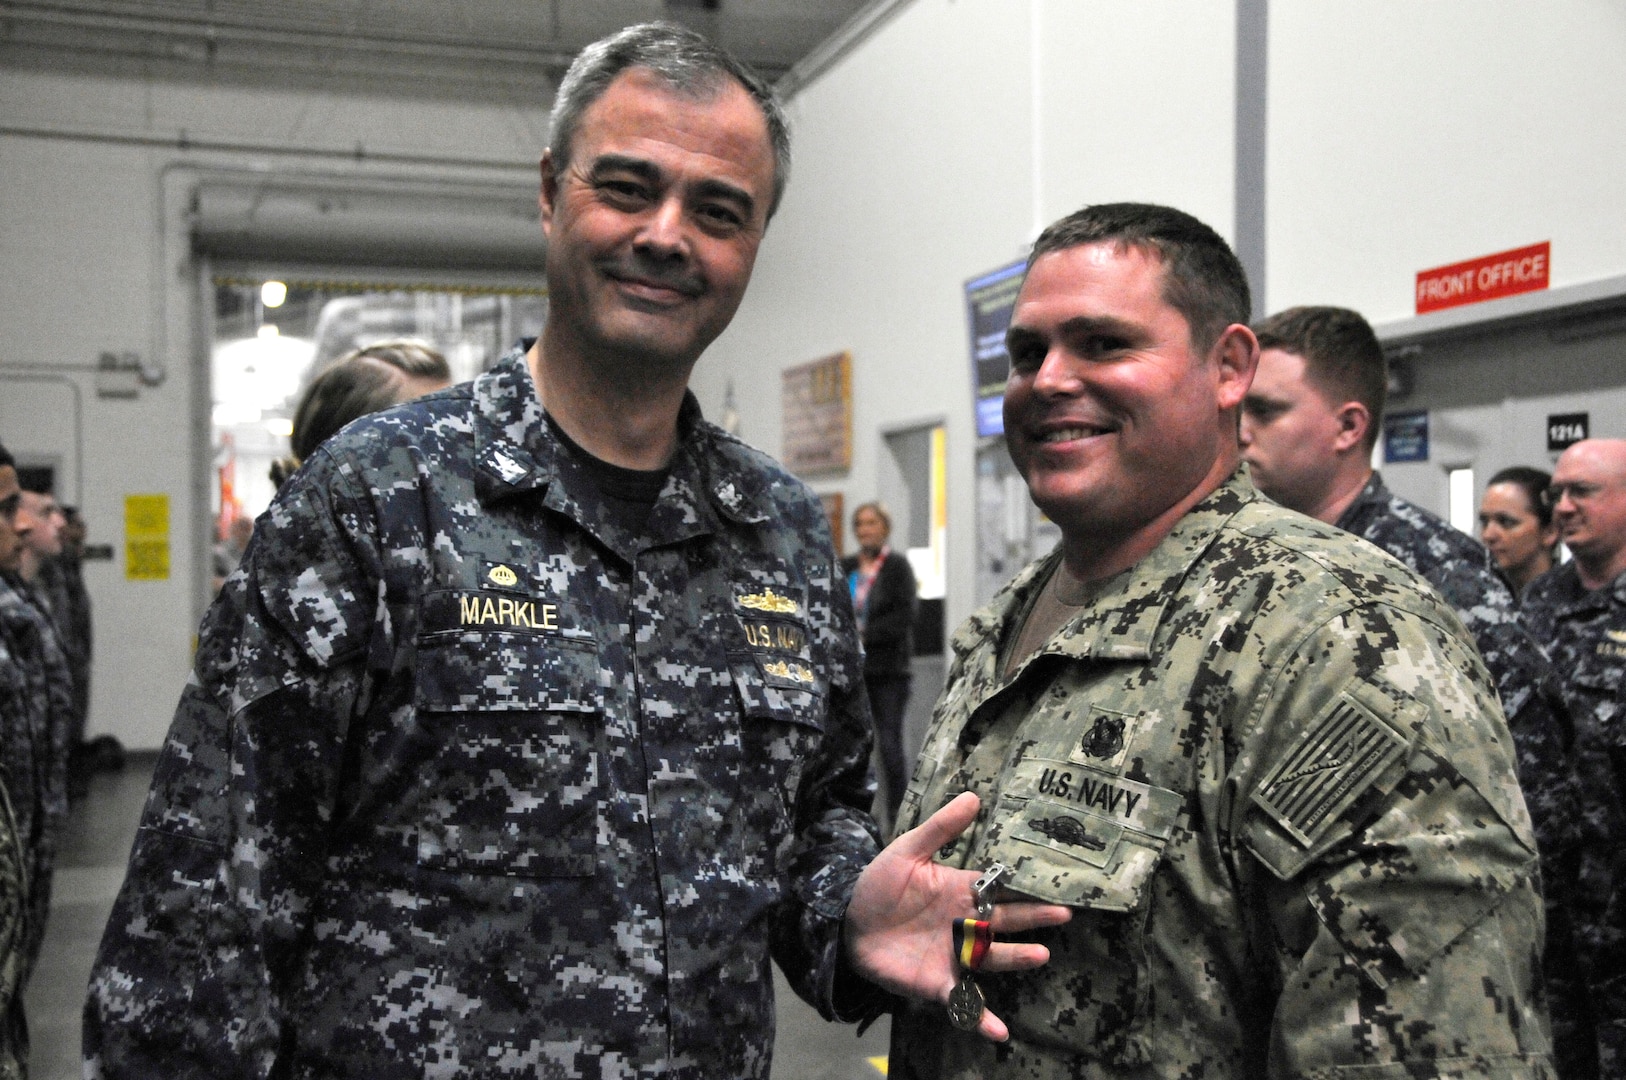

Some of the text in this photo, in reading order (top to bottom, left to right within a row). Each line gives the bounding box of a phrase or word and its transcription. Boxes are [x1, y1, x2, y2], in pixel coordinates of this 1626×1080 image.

[1417, 254, 1545, 302] FRONT OFFICE
[1550, 423, 1584, 442] 121A
[461, 596, 558, 630] MARKLE
[744, 624, 776, 648] U.S.
[1038, 768, 1141, 818] U.S. NAVY
